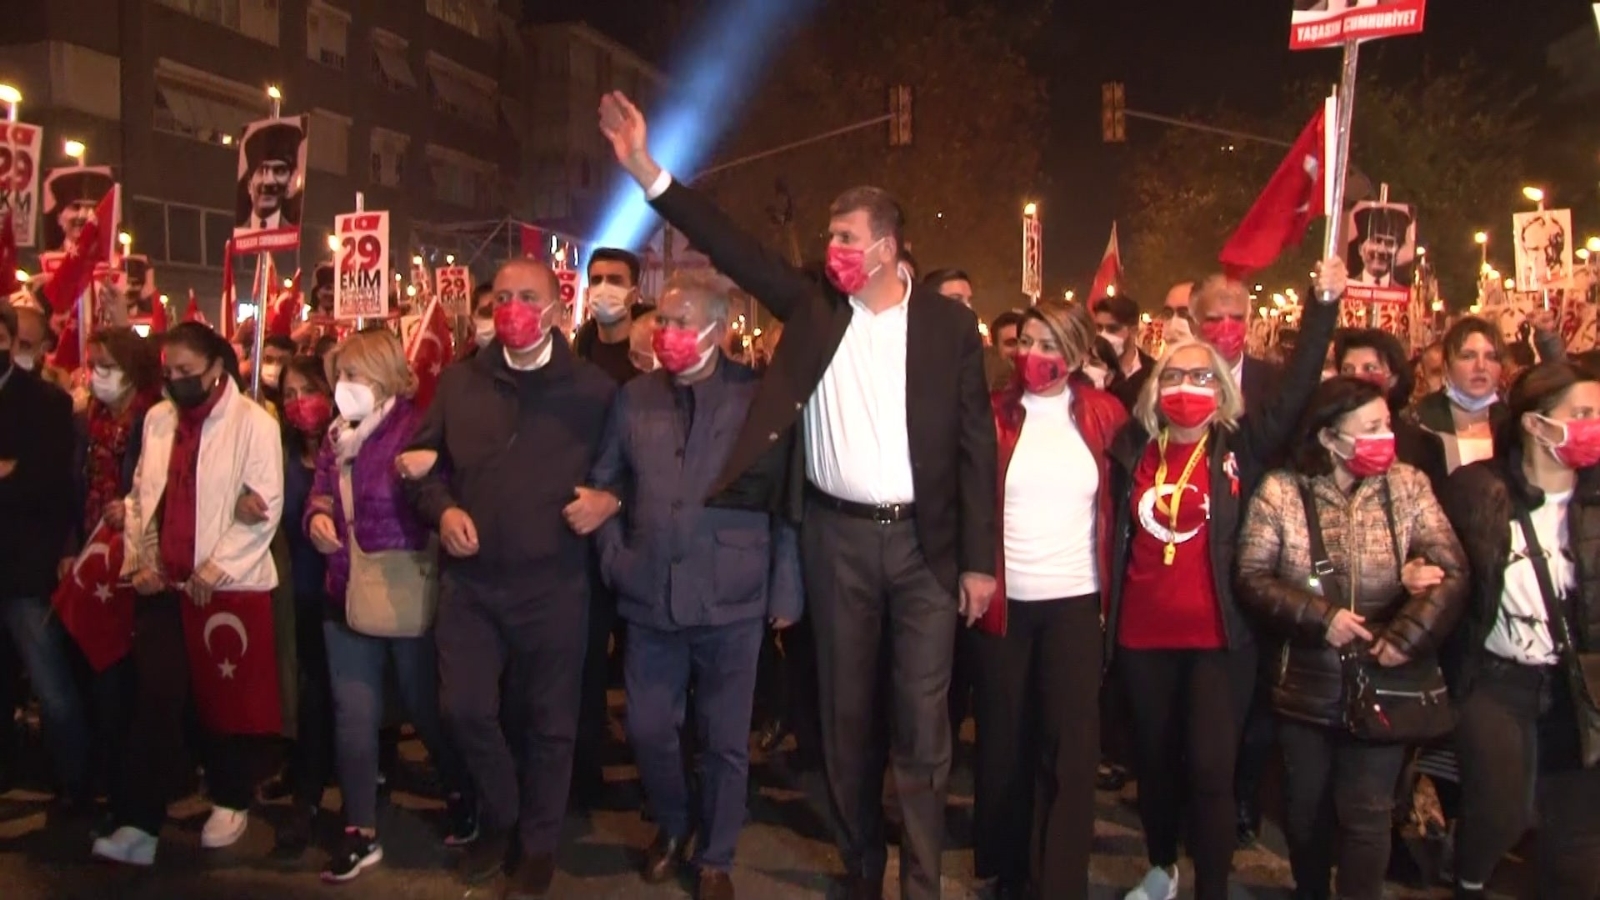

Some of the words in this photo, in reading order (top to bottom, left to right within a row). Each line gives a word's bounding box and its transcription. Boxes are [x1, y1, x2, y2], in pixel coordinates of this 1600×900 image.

[1297, 19, 1342, 42] YAŞASIN
[1343, 9, 1417, 33] CUMHURİYET
[341, 234, 381, 271] 29
[340, 268, 381, 290] EKİM
[441, 278, 466, 296] 29
